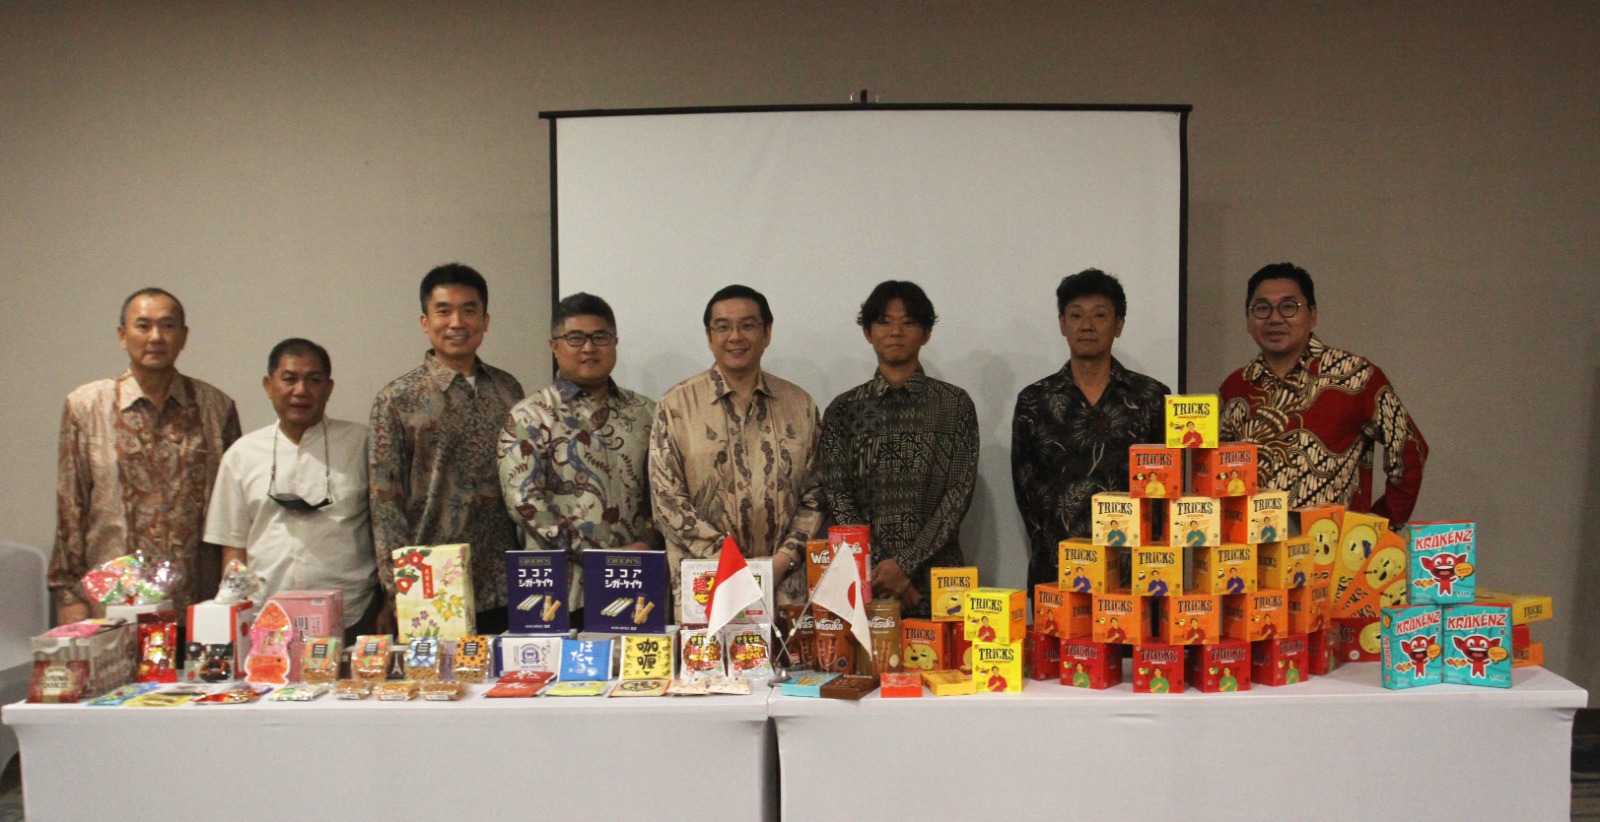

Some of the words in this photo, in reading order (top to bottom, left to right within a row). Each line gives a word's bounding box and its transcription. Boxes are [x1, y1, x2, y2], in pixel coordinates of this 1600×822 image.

[1173, 402, 1210, 416] TRICKS
[1136, 453, 1172, 466] TRICKS
[1219, 451, 1251, 465] TRICKS
[1098, 502, 1132, 515] TRICKS
[1177, 502, 1213, 515] TRICKS
[1254, 498, 1282, 512] TRICKS
[1414, 528, 1473, 551] KRAKENZ
[1065, 549, 1098, 562] TRICKS
[1218, 549, 1250, 562] TRICKS
[1288, 543, 1310, 557] TRICKS
[1139, 552, 1175, 564] TRICKS
[937, 576, 971, 589] TRICKS
[970, 597, 1002, 612] TRICKS
[1039, 591, 1064, 607] TRICKS
[1098, 599, 1133, 612] TRICKS
[1254, 595, 1283, 609] TRICKS
[1178, 600, 1213, 612] TRICKS
[1524, 604, 1543, 617] TRICKS
[815, 618, 843, 630] Wasuka
[1396, 610, 1441, 635] KRAKENZ
[1447, 612, 1507, 630] KRAKENZ
[905, 627, 936, 641] TRICKS
[979, 648, 1014, 661] TRICKS
[1066, 643, 1098, 659] TRICKS
[1142, 649, 1177, 663] TRICKS
[1211, 648, 1246, 661] TRICKS
